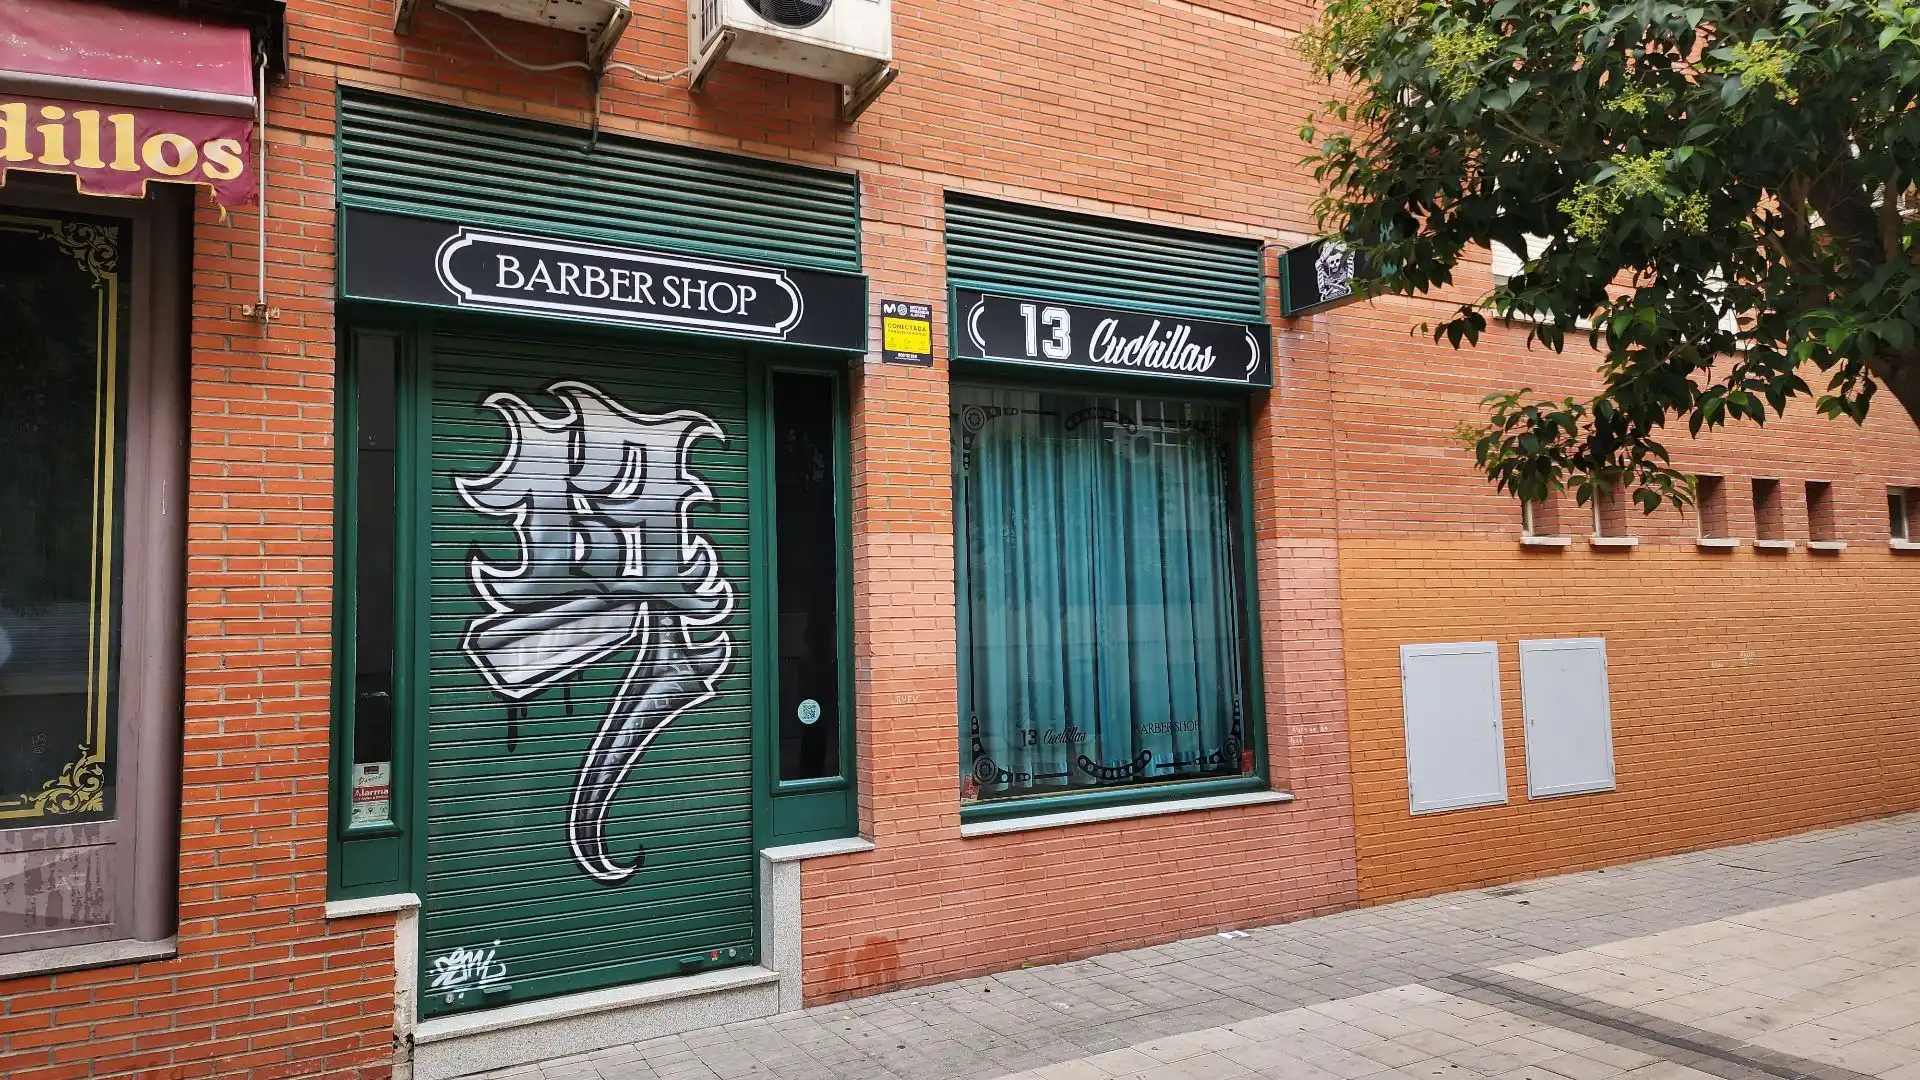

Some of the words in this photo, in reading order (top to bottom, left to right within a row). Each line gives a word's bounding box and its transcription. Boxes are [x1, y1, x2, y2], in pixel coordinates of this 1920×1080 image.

[496, 254, 656, 305] BARBER
[662, 277, 757, 316] SHOP
[1020, 303, 1071, 360] 13
[1088, 317, 1217, 373] Cuchillas
[1020, 729, 1037, 746] 13
[1043, 727, 1088, 745] Cuchillas
[355, 788, 389, 797] Alarma
